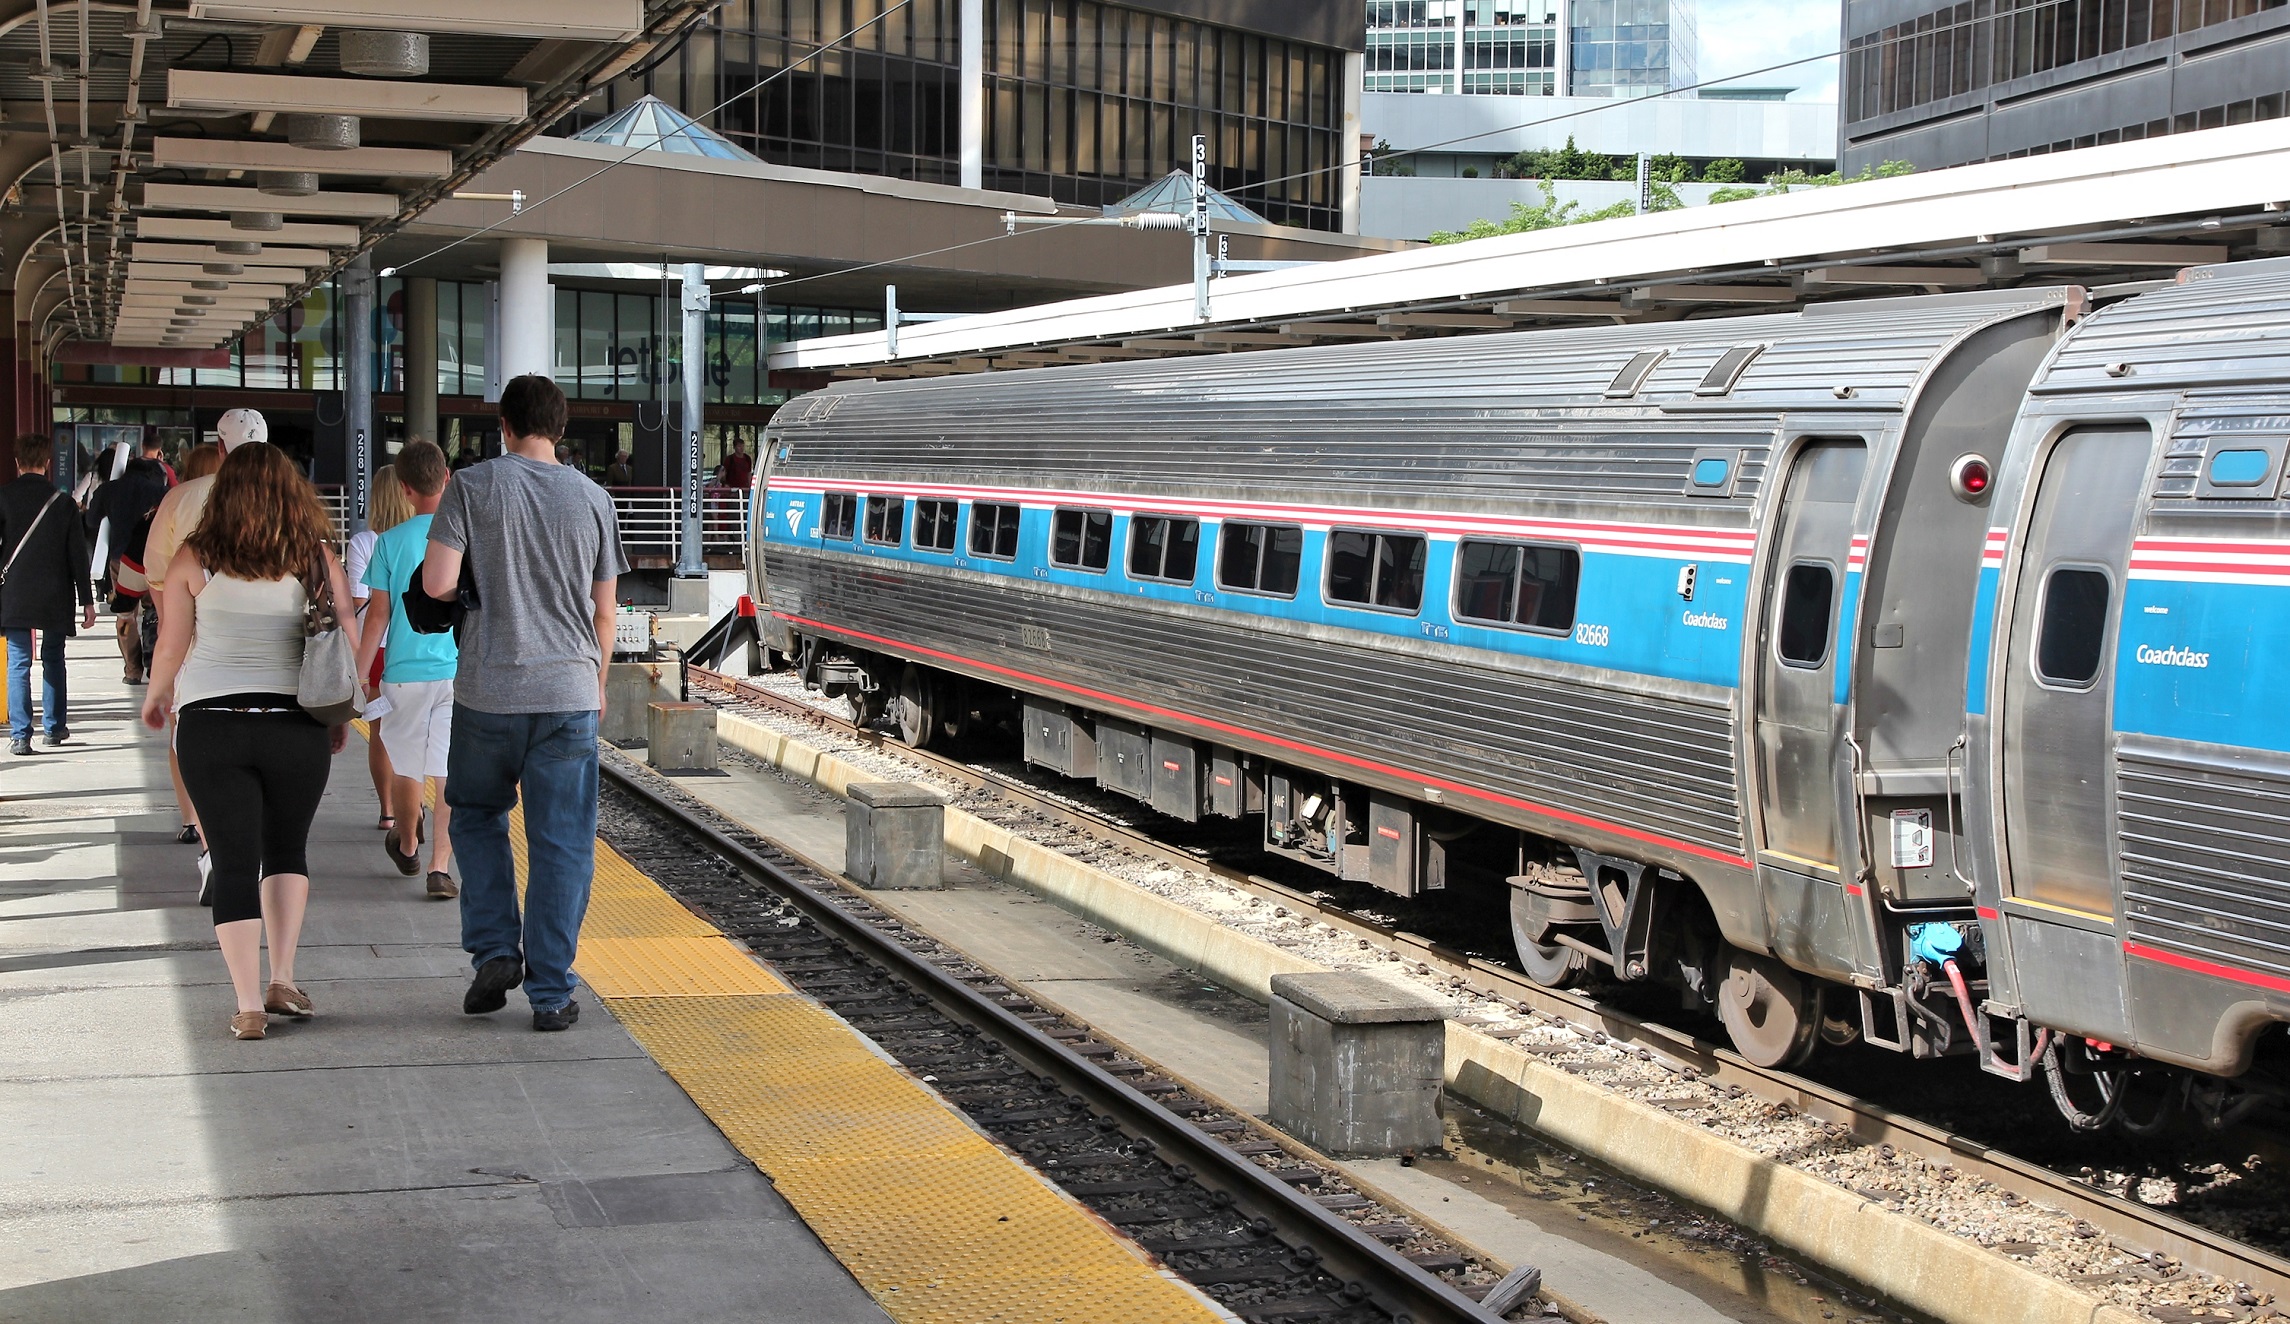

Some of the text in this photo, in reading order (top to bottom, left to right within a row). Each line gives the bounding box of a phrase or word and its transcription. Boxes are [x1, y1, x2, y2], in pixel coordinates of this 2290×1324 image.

[1196, 143, 1206, 229] 306-B
[604, 332, 731, 395] jetBle
[59, 449, 68, 477] Taxis
[357, 433, 365, 515] 228-347
[690, 433, 698, 514] 228-348
[1683, 610, 1728, 630] Coachclass
[2143, 605, 2169, 614] welcome
[1576, 622, 1609, 647] 82668
[2136, 643, 2210, 668] Coachclass
